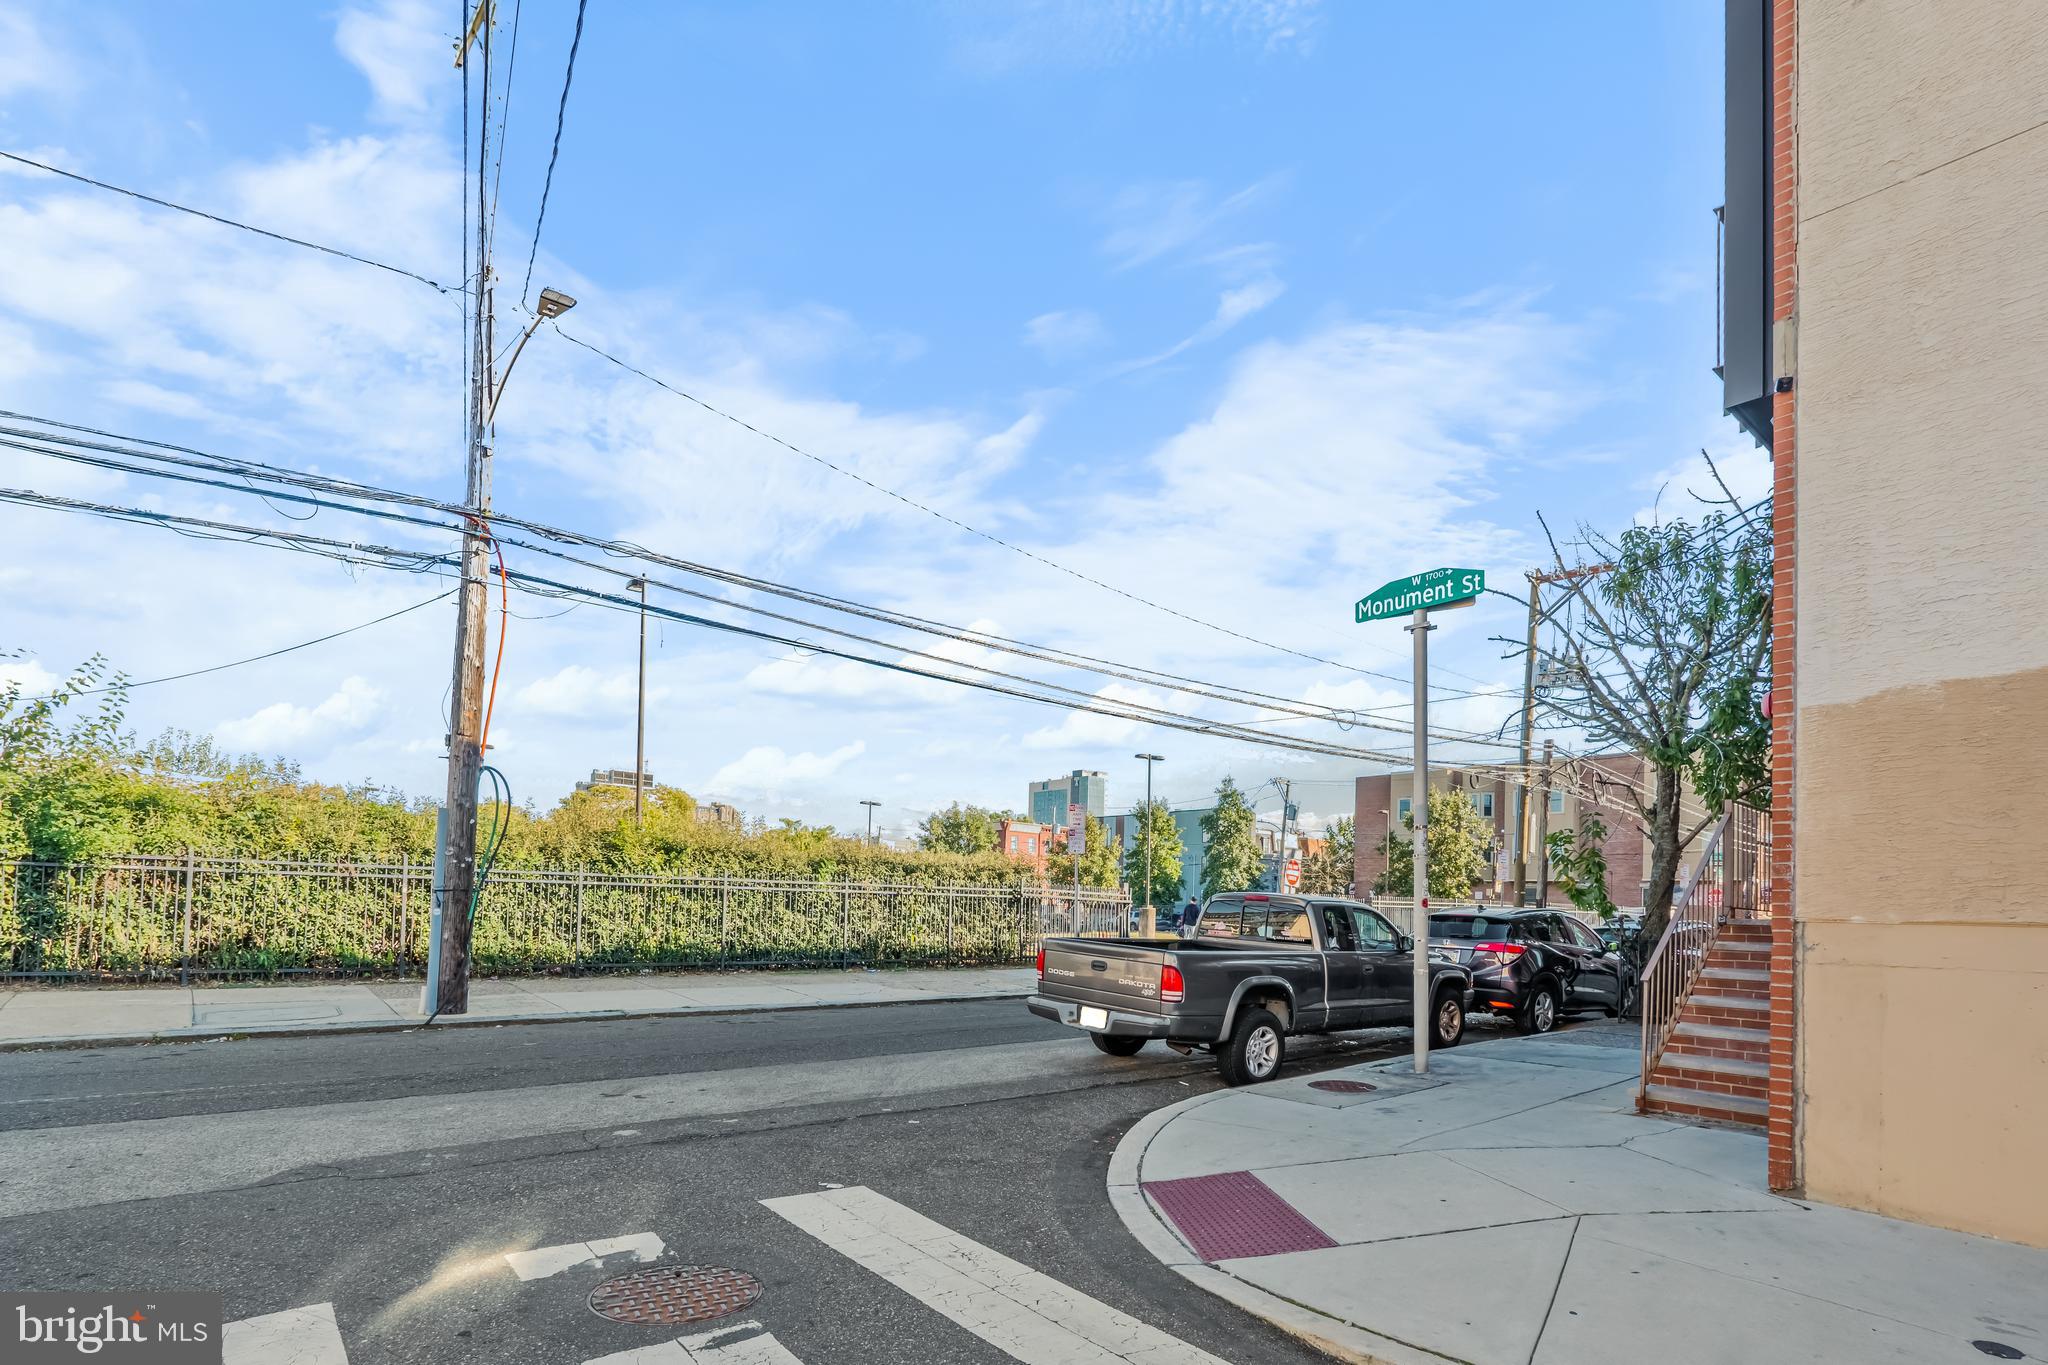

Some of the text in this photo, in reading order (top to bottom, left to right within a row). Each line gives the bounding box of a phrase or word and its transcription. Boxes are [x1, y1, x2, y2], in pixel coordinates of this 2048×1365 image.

[1411, 570, 1444, 586] W 1700
[1358, 574, 1481, 619] Monument St
[1047, 967, 1075, 977] DODGE
[1118, 978, 1156, 990] DAKOTA
